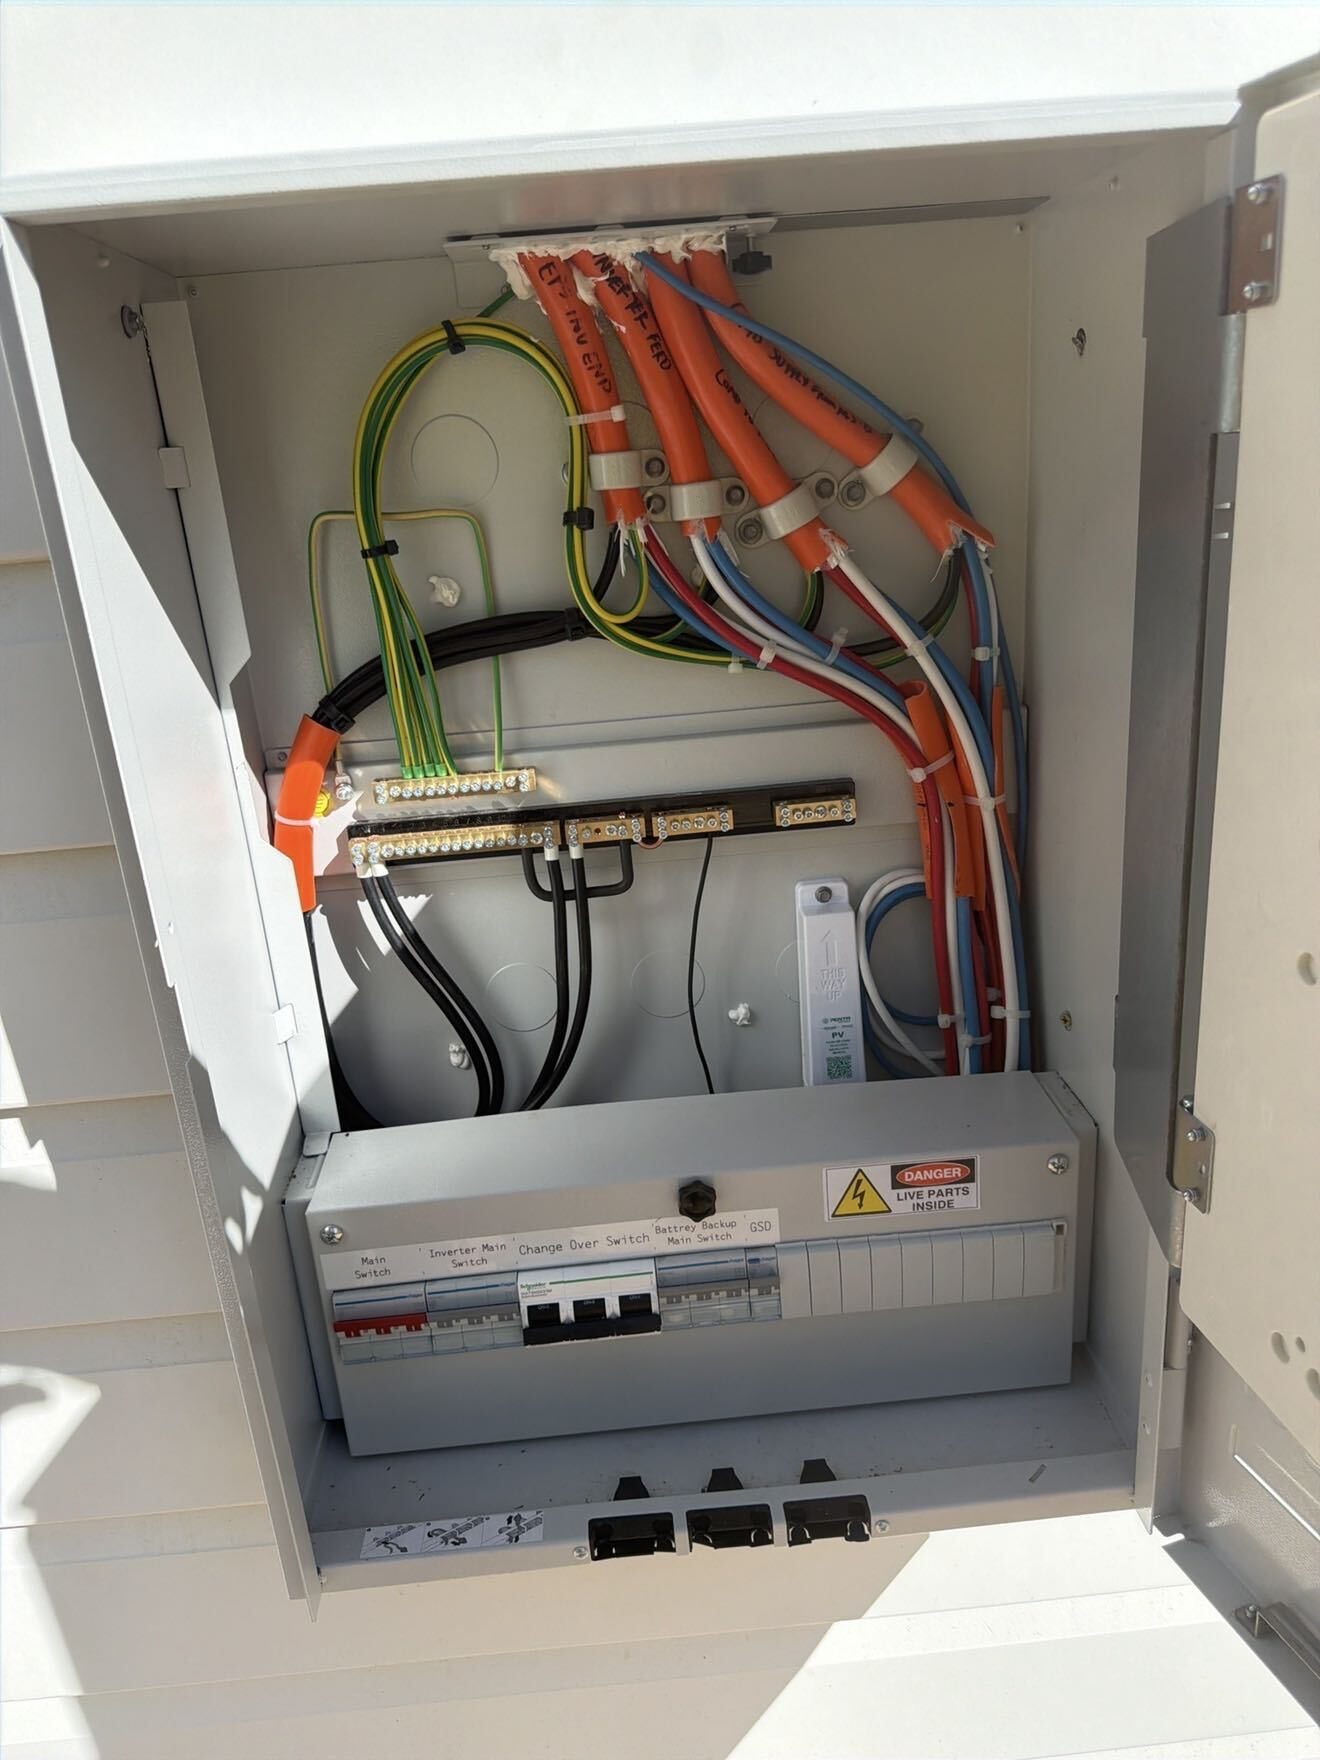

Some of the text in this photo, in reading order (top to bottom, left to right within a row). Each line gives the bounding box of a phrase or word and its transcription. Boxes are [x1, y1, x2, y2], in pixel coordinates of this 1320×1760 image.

[566, 310, 588, 346] INV
[582, 351, 613, 394] END
[820, 967, 848, 981] THIS
[819, 978, 848, 994] WAY
[826, 990, 841, 1002] UP
[831, 1031, 845, 1040] PV
[904, 1167, 962, 1182] DANGER
[896, 1186, 970, 1202] LIVE PARTS
[912, 1199, 955, 1212] INSIDE
[655, 1219, 737, 1234] Battrey Backup
[750, 1221, 772, 1233] GSD
[518, 1231, 651, 1257] Change Over Switch
[668, 1232, 733, 1246] Main Switch
[429, 1242, 507, 1259] Inverter Main
[361, 1256, 386, 1266] Main
[452, 1257, 488, 1269] Switch
[355, 1269, 391, 1280] Switch
